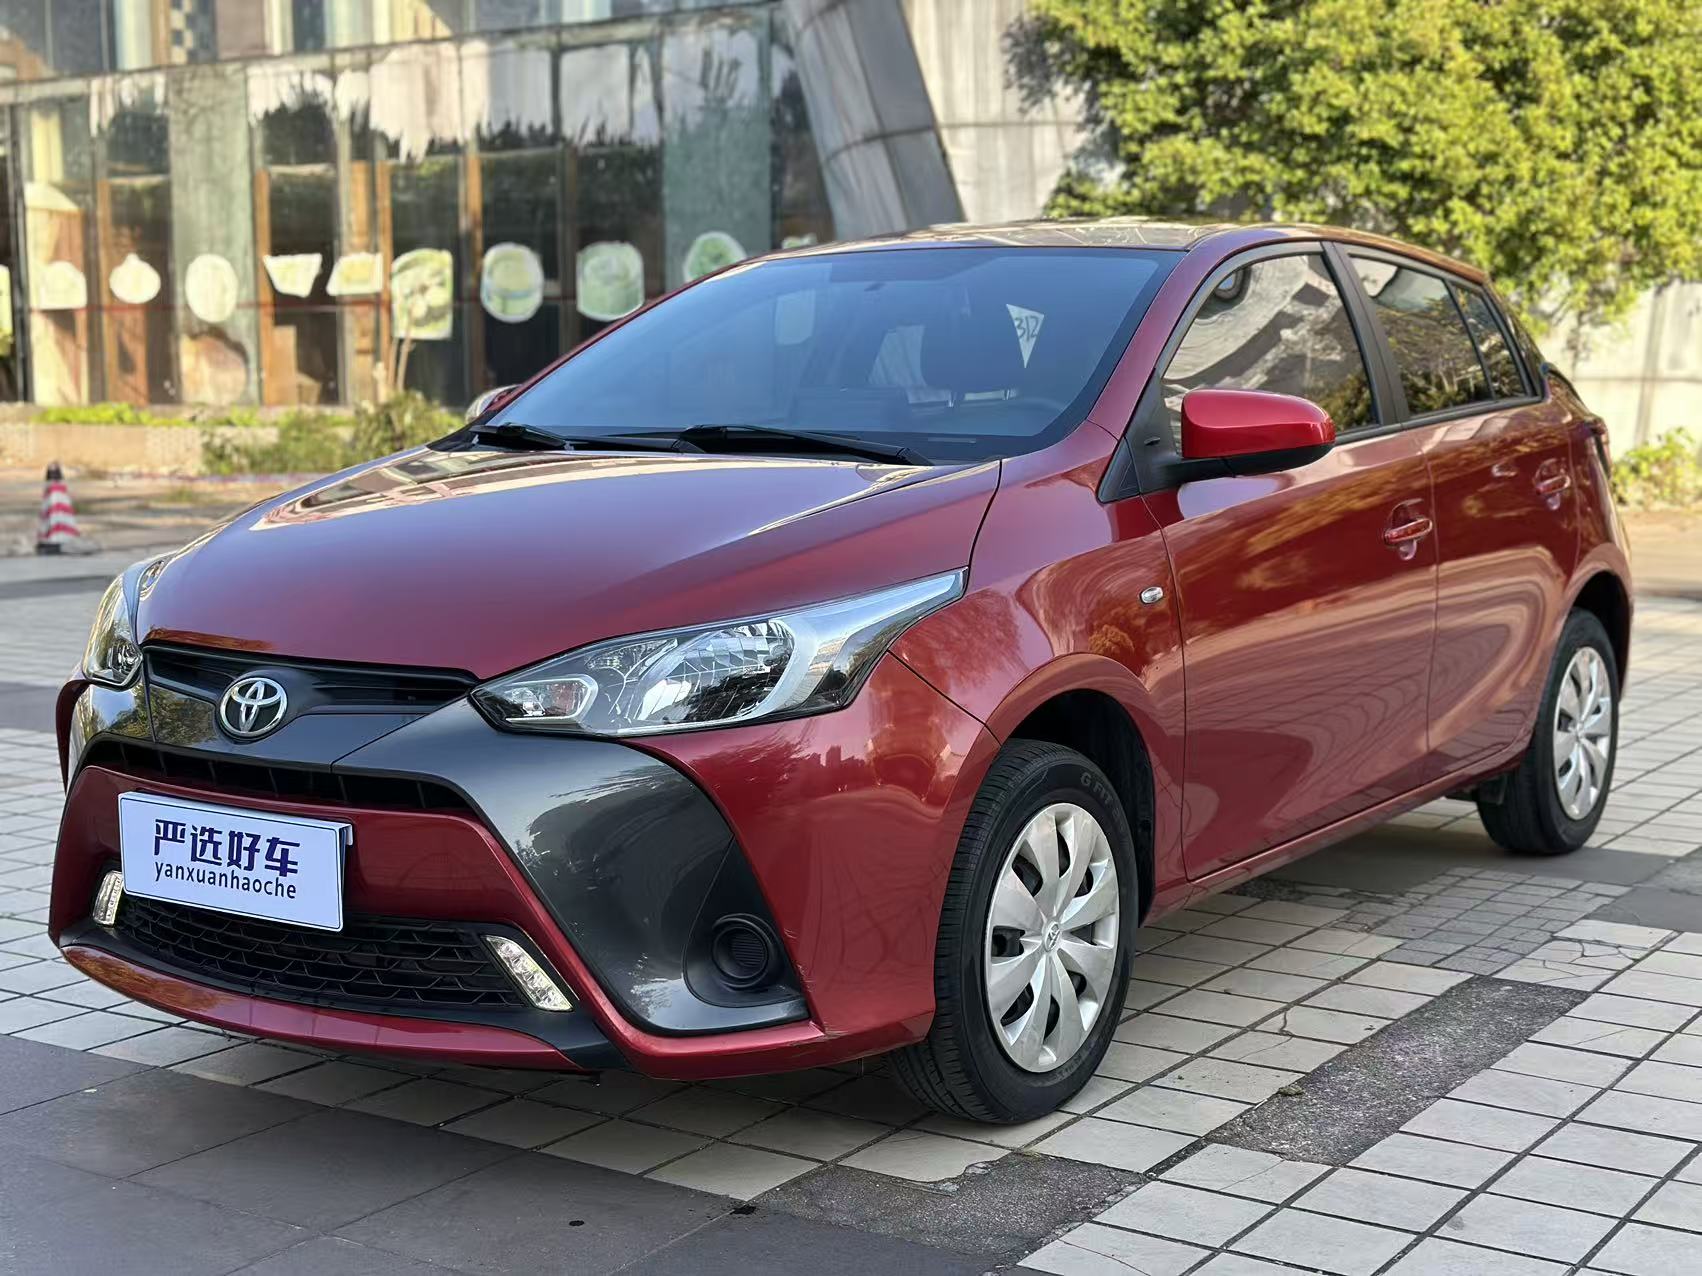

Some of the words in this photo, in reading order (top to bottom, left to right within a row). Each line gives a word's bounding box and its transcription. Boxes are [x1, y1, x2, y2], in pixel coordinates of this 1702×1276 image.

[154, 818, 301, 877] 严选好车
[154, 861, 297, 899] yanxuanhaoche
